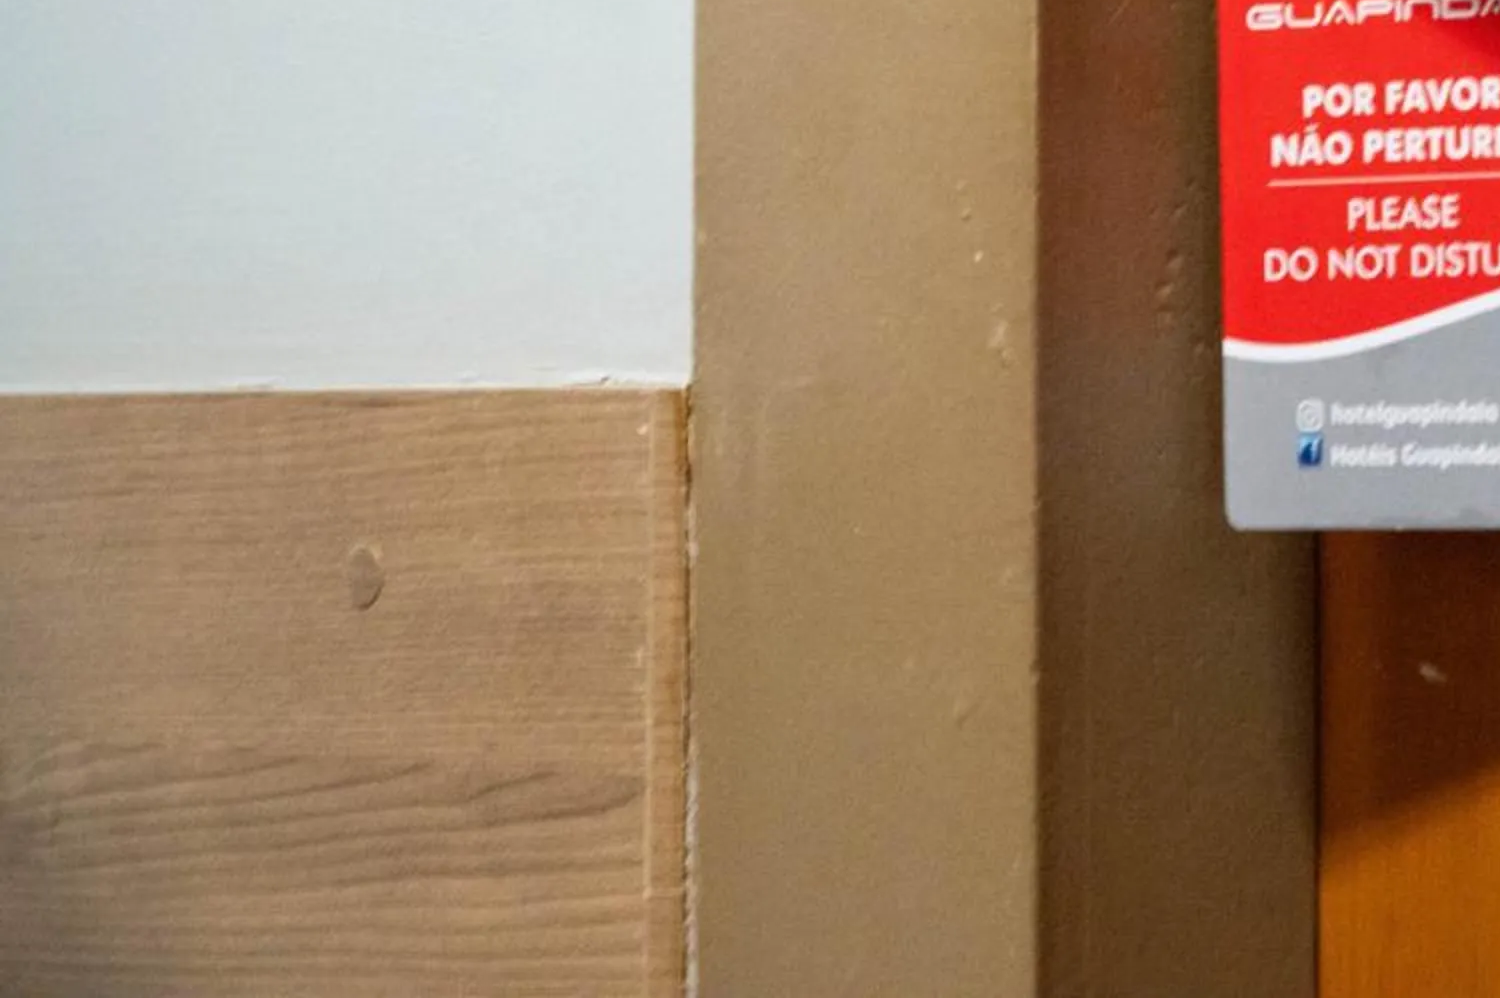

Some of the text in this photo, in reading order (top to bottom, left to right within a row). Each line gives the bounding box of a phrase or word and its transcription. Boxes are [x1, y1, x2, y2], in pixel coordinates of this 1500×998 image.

[1303, 83, 1375, 118] POR
[1271, 124, 1353, 167] NÃO
[1347, 194, 1461, 232] PLEASE
[1264, 249, 1317, 281] DO
[1327, 244, 1403, 278] NOT
